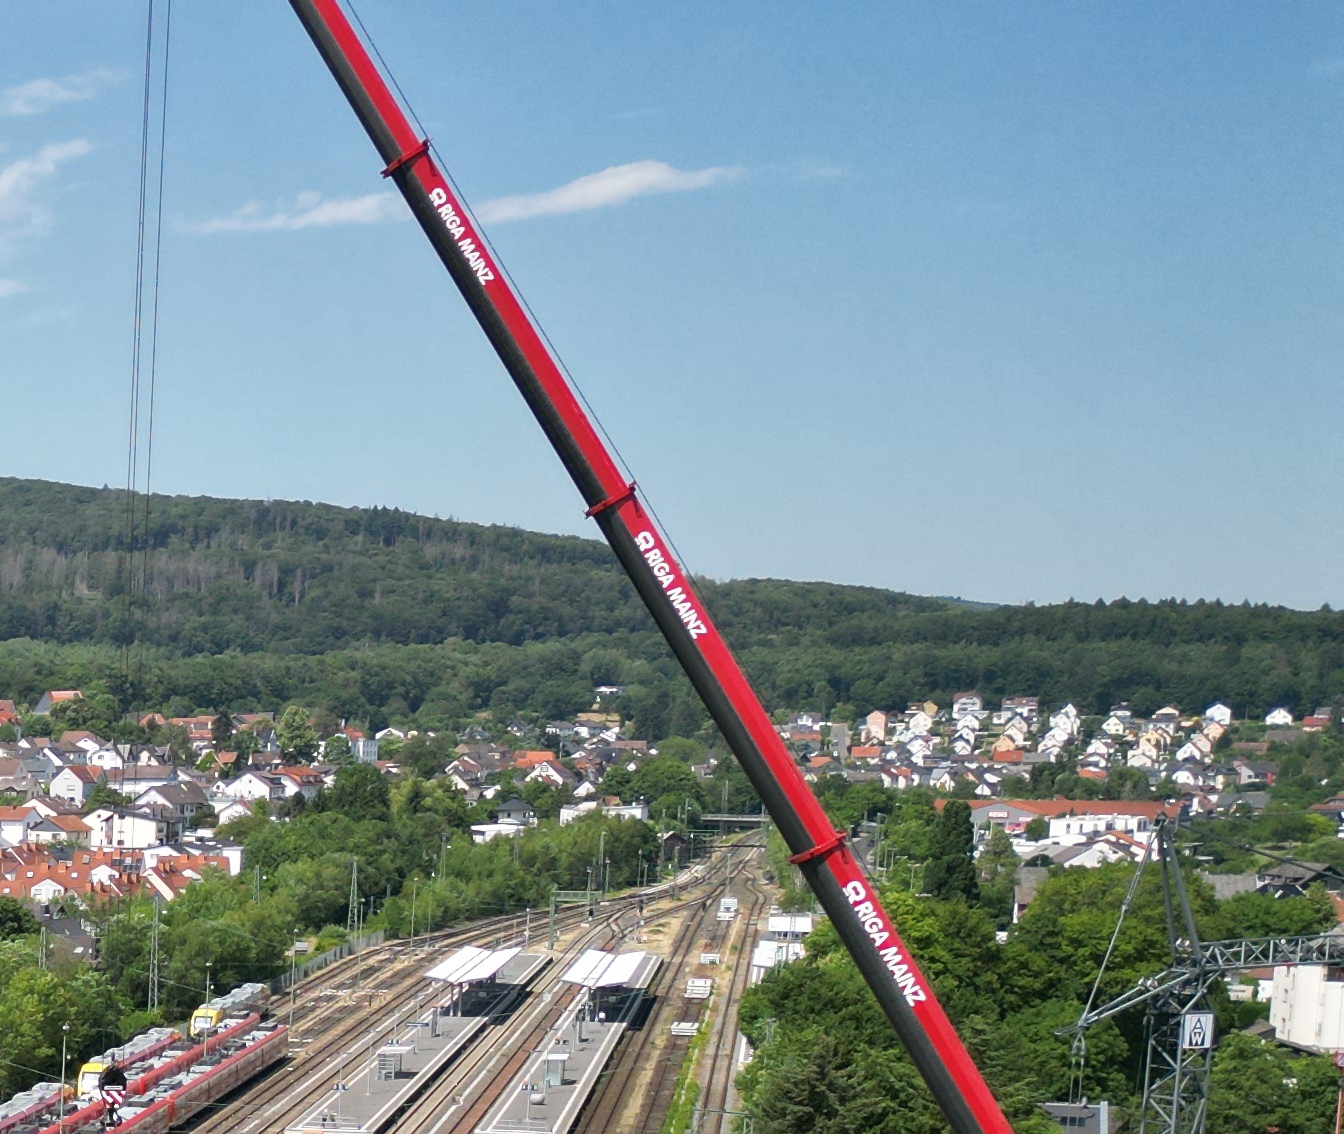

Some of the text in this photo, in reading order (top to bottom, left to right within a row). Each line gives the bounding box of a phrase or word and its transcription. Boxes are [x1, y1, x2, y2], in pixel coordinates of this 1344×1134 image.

[438, 203, 494, 285] RIGA MAINZ
[644, 548, 707, 639] RIGA MAINZ
[854, 901, 926, 1007] RIGA MAINZ
